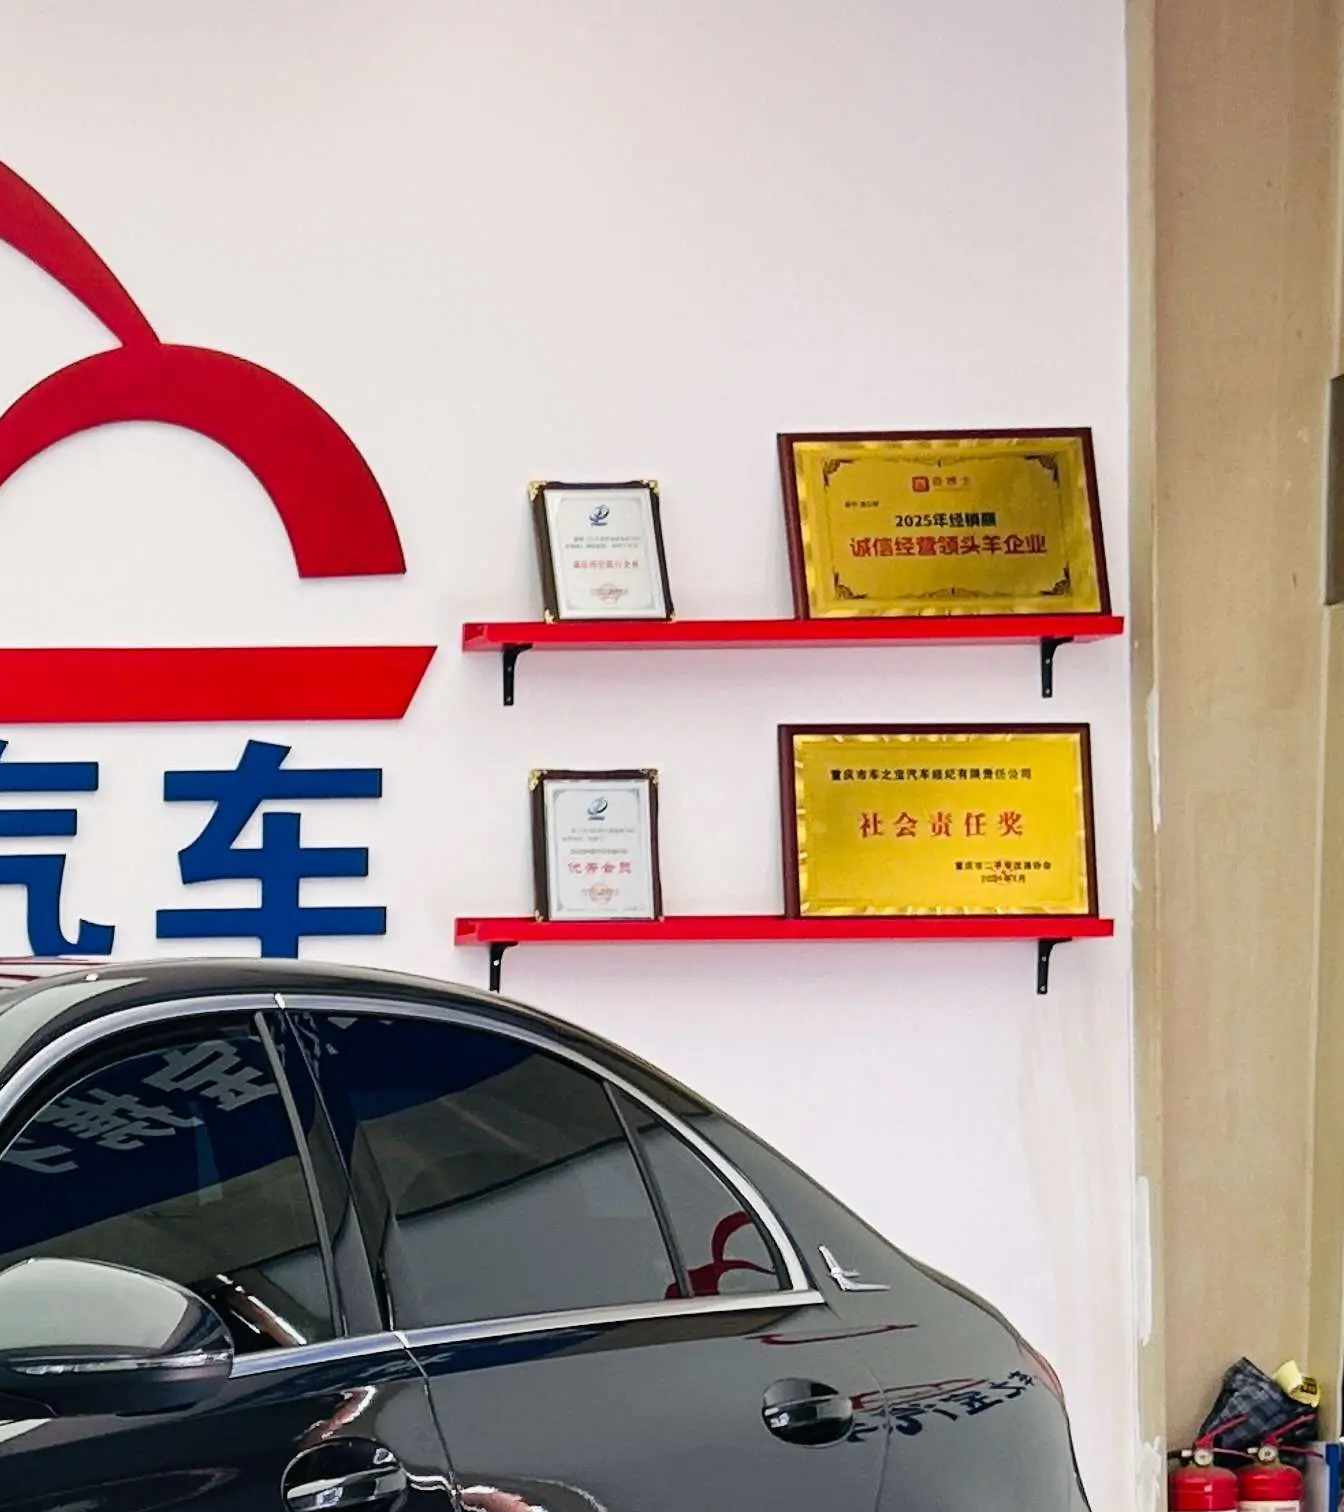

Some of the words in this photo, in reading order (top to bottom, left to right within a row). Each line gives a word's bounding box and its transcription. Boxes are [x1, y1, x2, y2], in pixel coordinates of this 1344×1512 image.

[850, 533, 1047, 558] 诚信经营领头羊企业
[859, 811, 1024, 838] 社会责任奖
